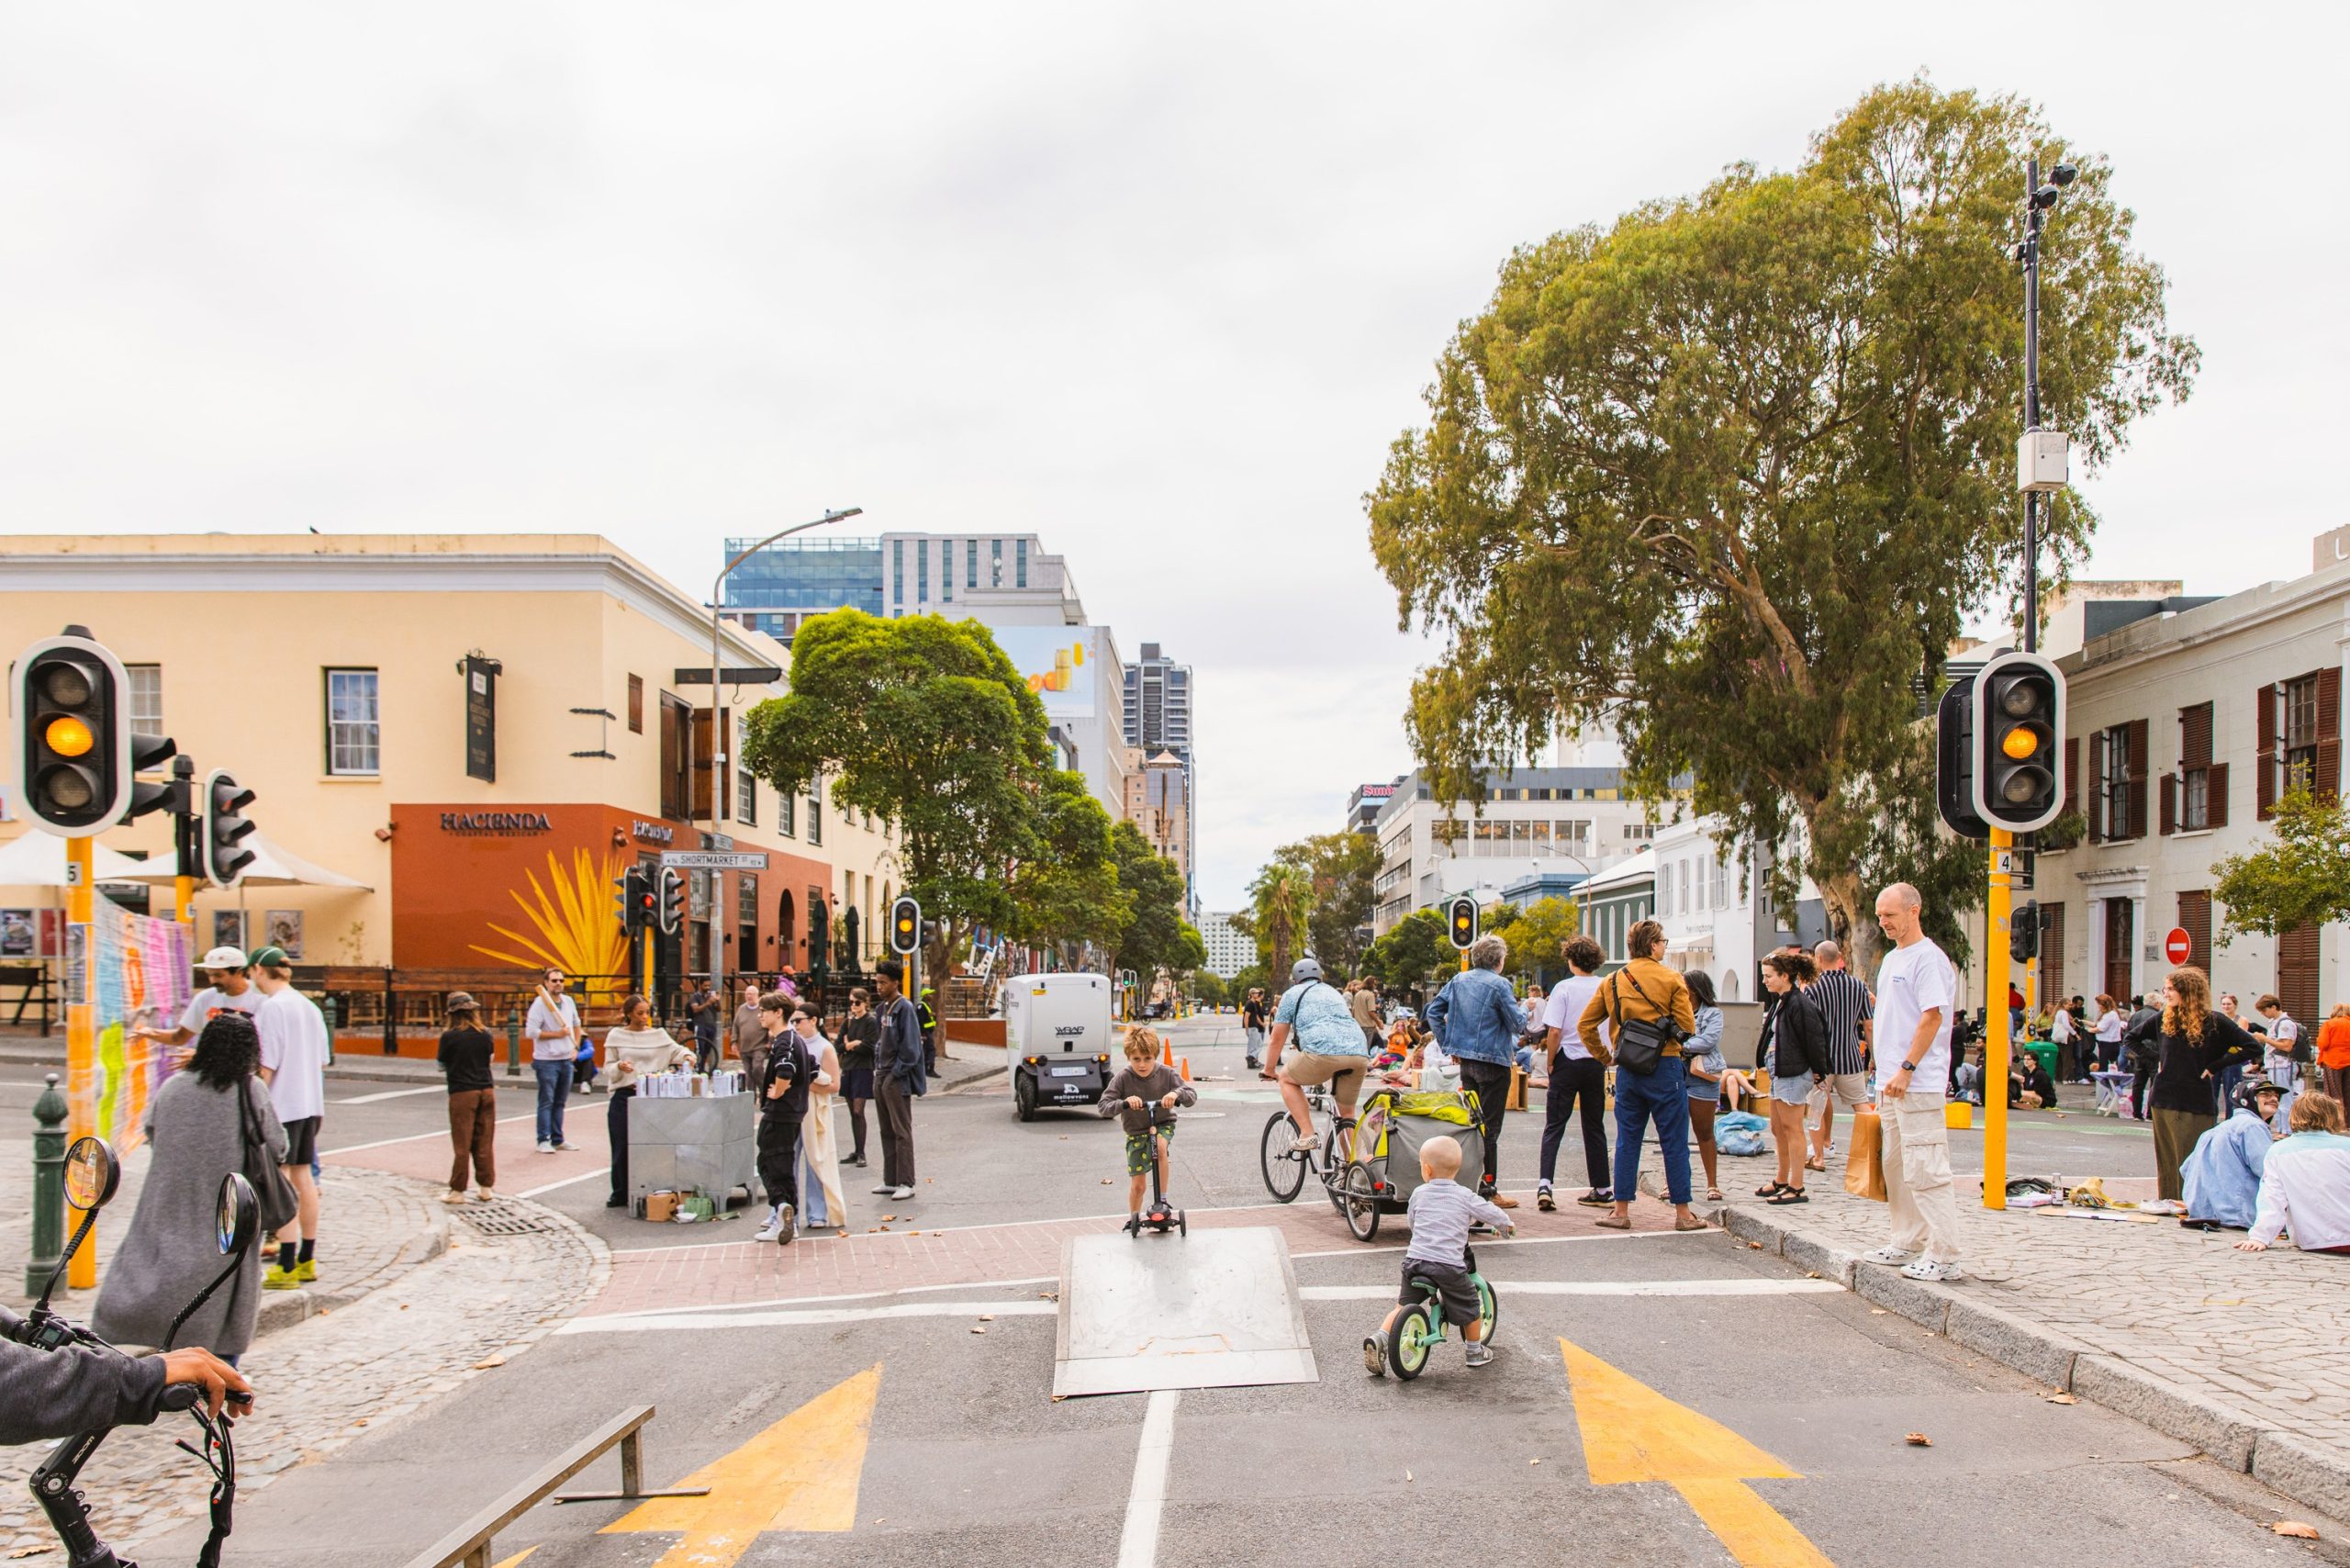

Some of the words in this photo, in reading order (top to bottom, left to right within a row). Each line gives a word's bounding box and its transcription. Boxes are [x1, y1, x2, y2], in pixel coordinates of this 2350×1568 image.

[1362, 784, 1394, 797] Sund
[441, 813, 552, 830] HACIENDA
[680, 855, 739, 866] SHORTMARKET
[2002, 856, 2010, 870] 4
[68, 865, 76, 882] 5
[2147, 931, 2157, 942] 93
[72, 1435, 95, 1465] ZOOM
